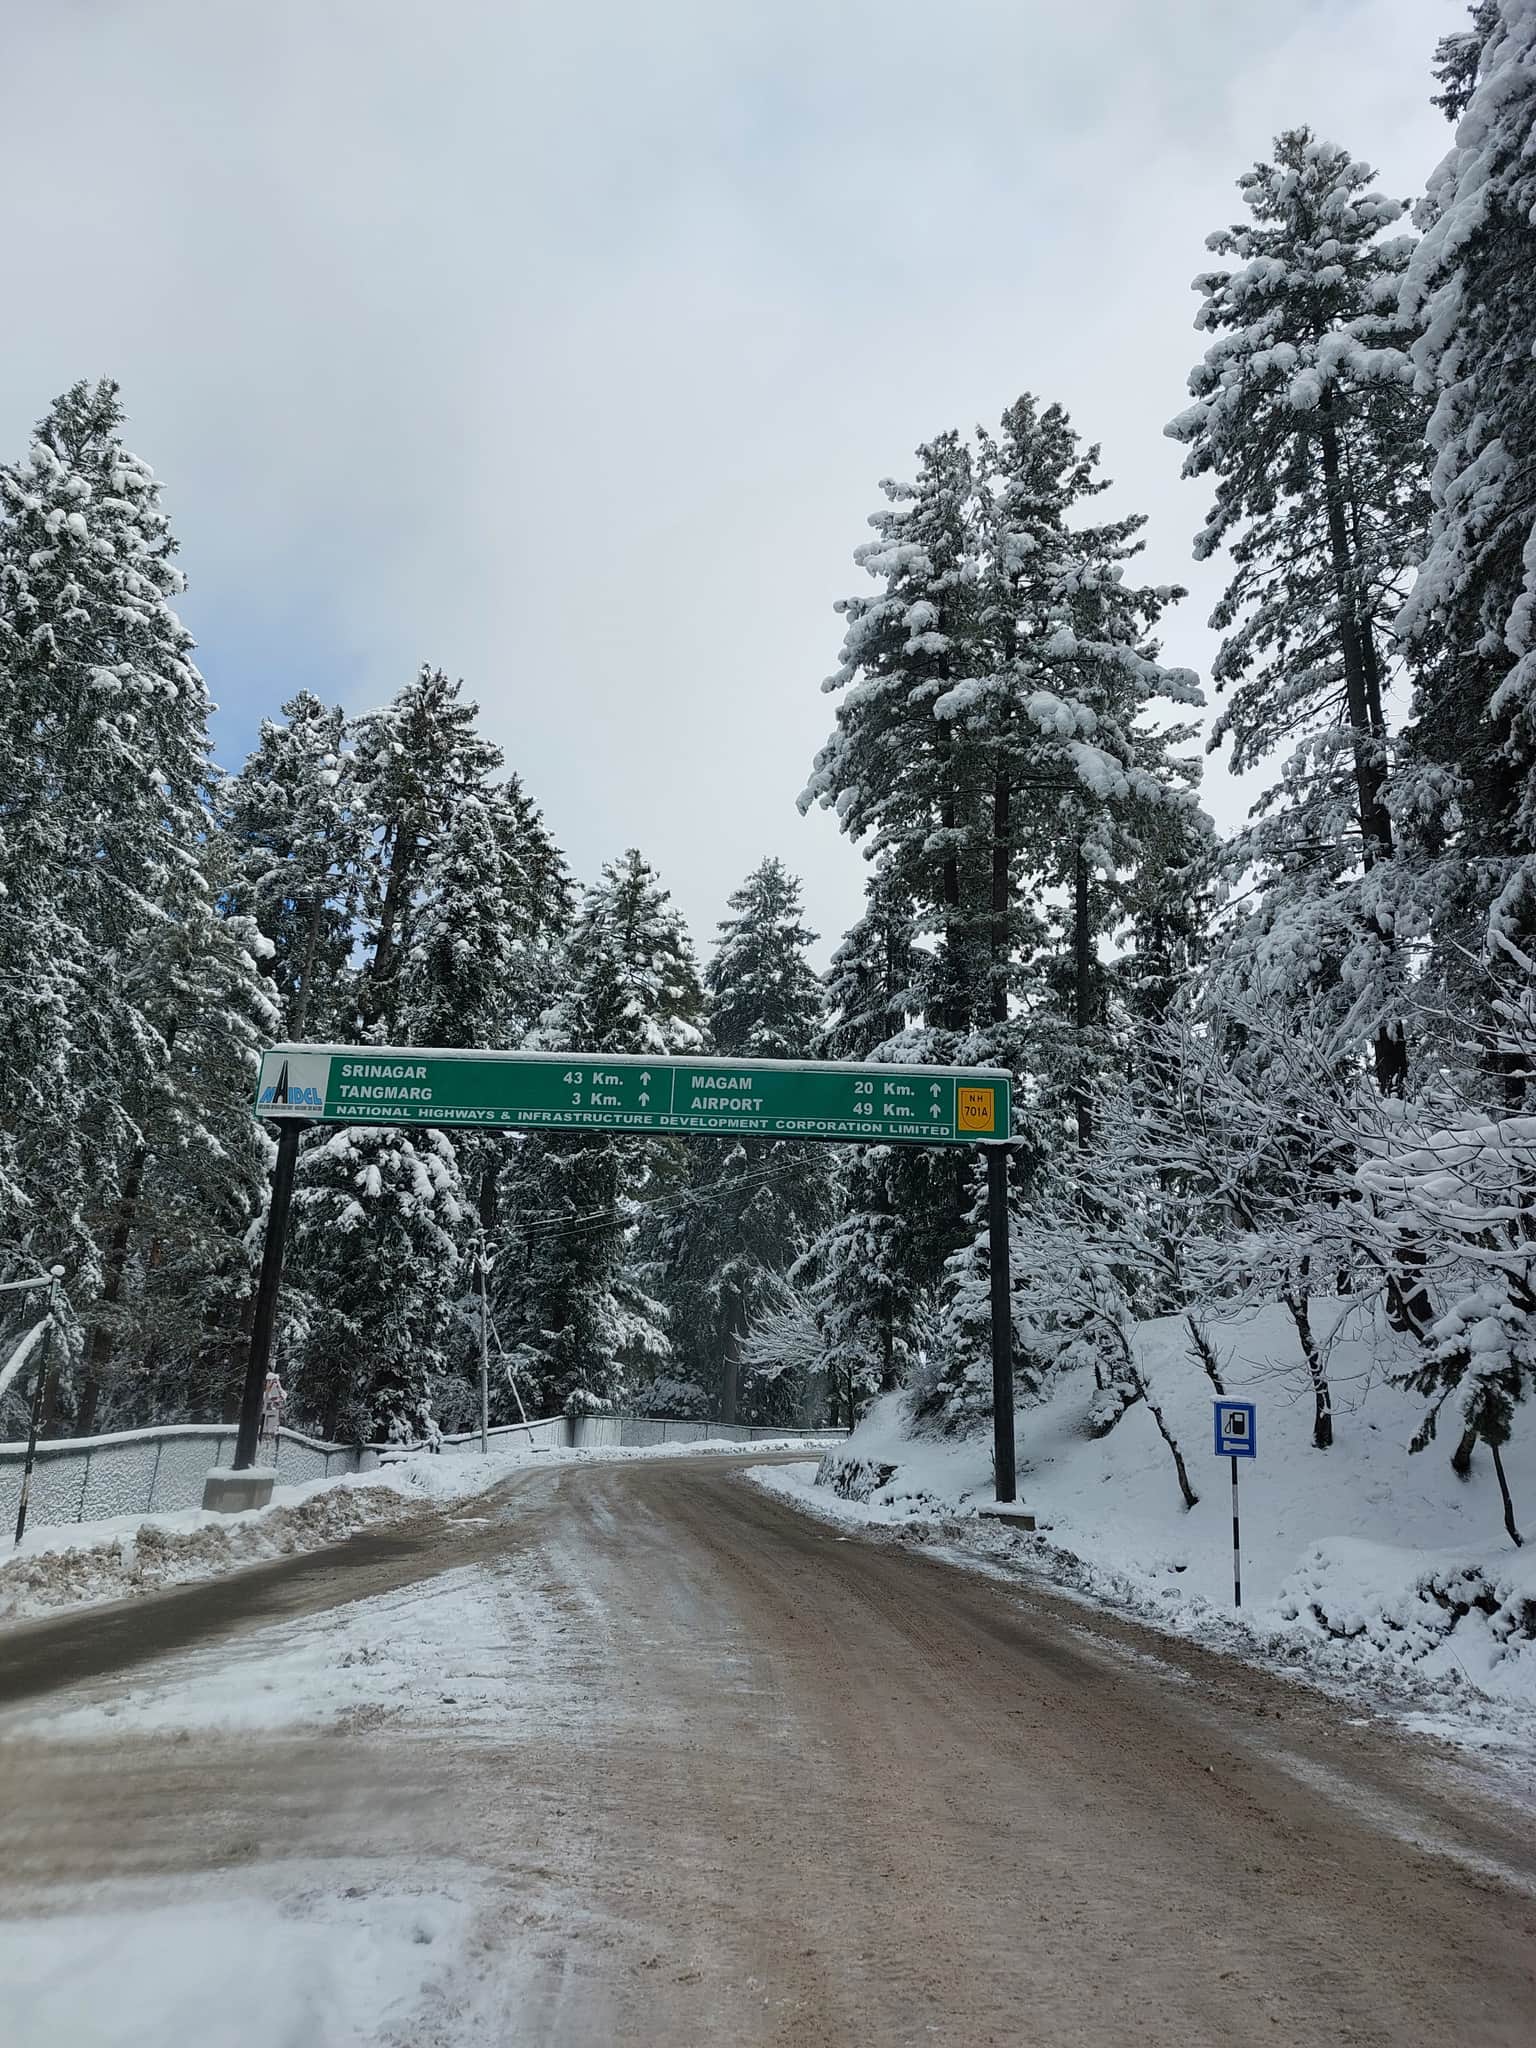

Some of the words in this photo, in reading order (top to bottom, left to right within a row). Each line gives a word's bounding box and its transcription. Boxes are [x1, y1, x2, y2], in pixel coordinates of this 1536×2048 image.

[341, 1064, 427, 1079] SRINAGAR
[563, 1071, 583, 1084] 43
[592, 1072, 624, 1086] Km.
[340, 1085, 433, 1100] TANGMARG
[571, 1092, 581, 1105] 3
[590, 1093, 622, 1106] Km.
[691, 1076, 752, 1090] MAGAM
[854, 1081, 874, 1094] 20
[883, 1082, 915, 1096] Km.
[690, 1097, 763, 1111] AIRPORT
[853, 1102, 873, 1115] 49
[883, 1103, 915, 1117] Km.
[964, 1106, 988, 1117] 701A
[336, 1105, 411, 1117] NATIONAL
[418, 1108, 495, 1120] HIGHWAYS
[500, 1111, 511, 1120] &
[518, 1111, 653, 1124] INFRASTRUCTURE
[660, 1116, 768, 1129] DEVELOPMENT
[775, 1120, 882, 1133] CORPORATION
[889, 1124, 950, 1136] LIMITED
